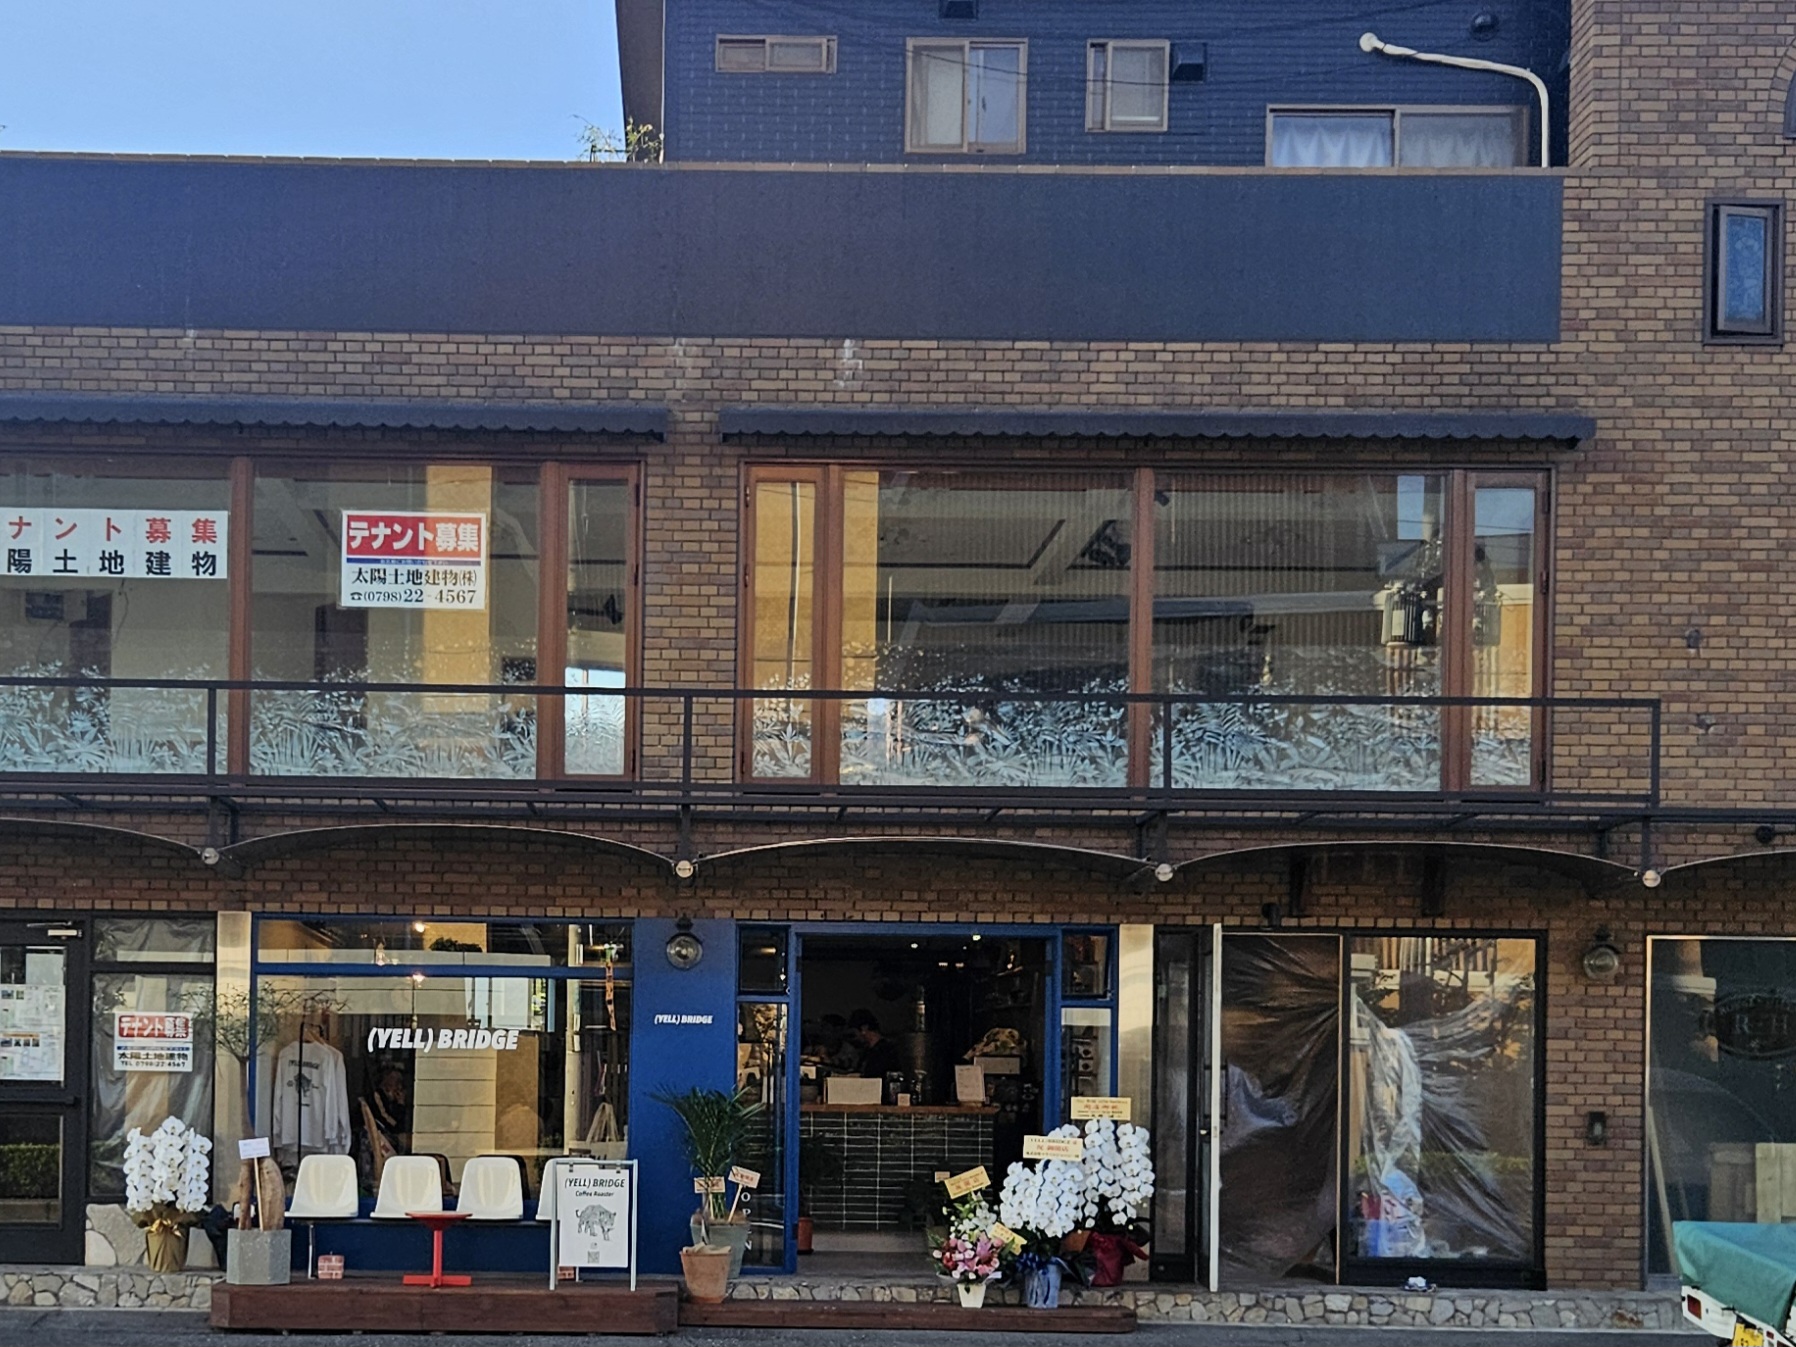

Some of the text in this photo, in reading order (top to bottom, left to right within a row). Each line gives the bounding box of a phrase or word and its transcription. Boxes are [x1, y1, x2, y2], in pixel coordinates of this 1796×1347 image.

[8, 515, 217, 544] ナント募集
[349, 521, 479, 552] テナント募集
[7, 548, 217, 576] 陽土地建物
[120, 1016, 187, 1037] テナント募集
[654, 1014, 713, 1025] (YELL) BRIDGE
[367, 1027, 520, 1053] (YELL) BRIDGE
[564, 1177, 626, 1189] (YELL) BRIDGE
